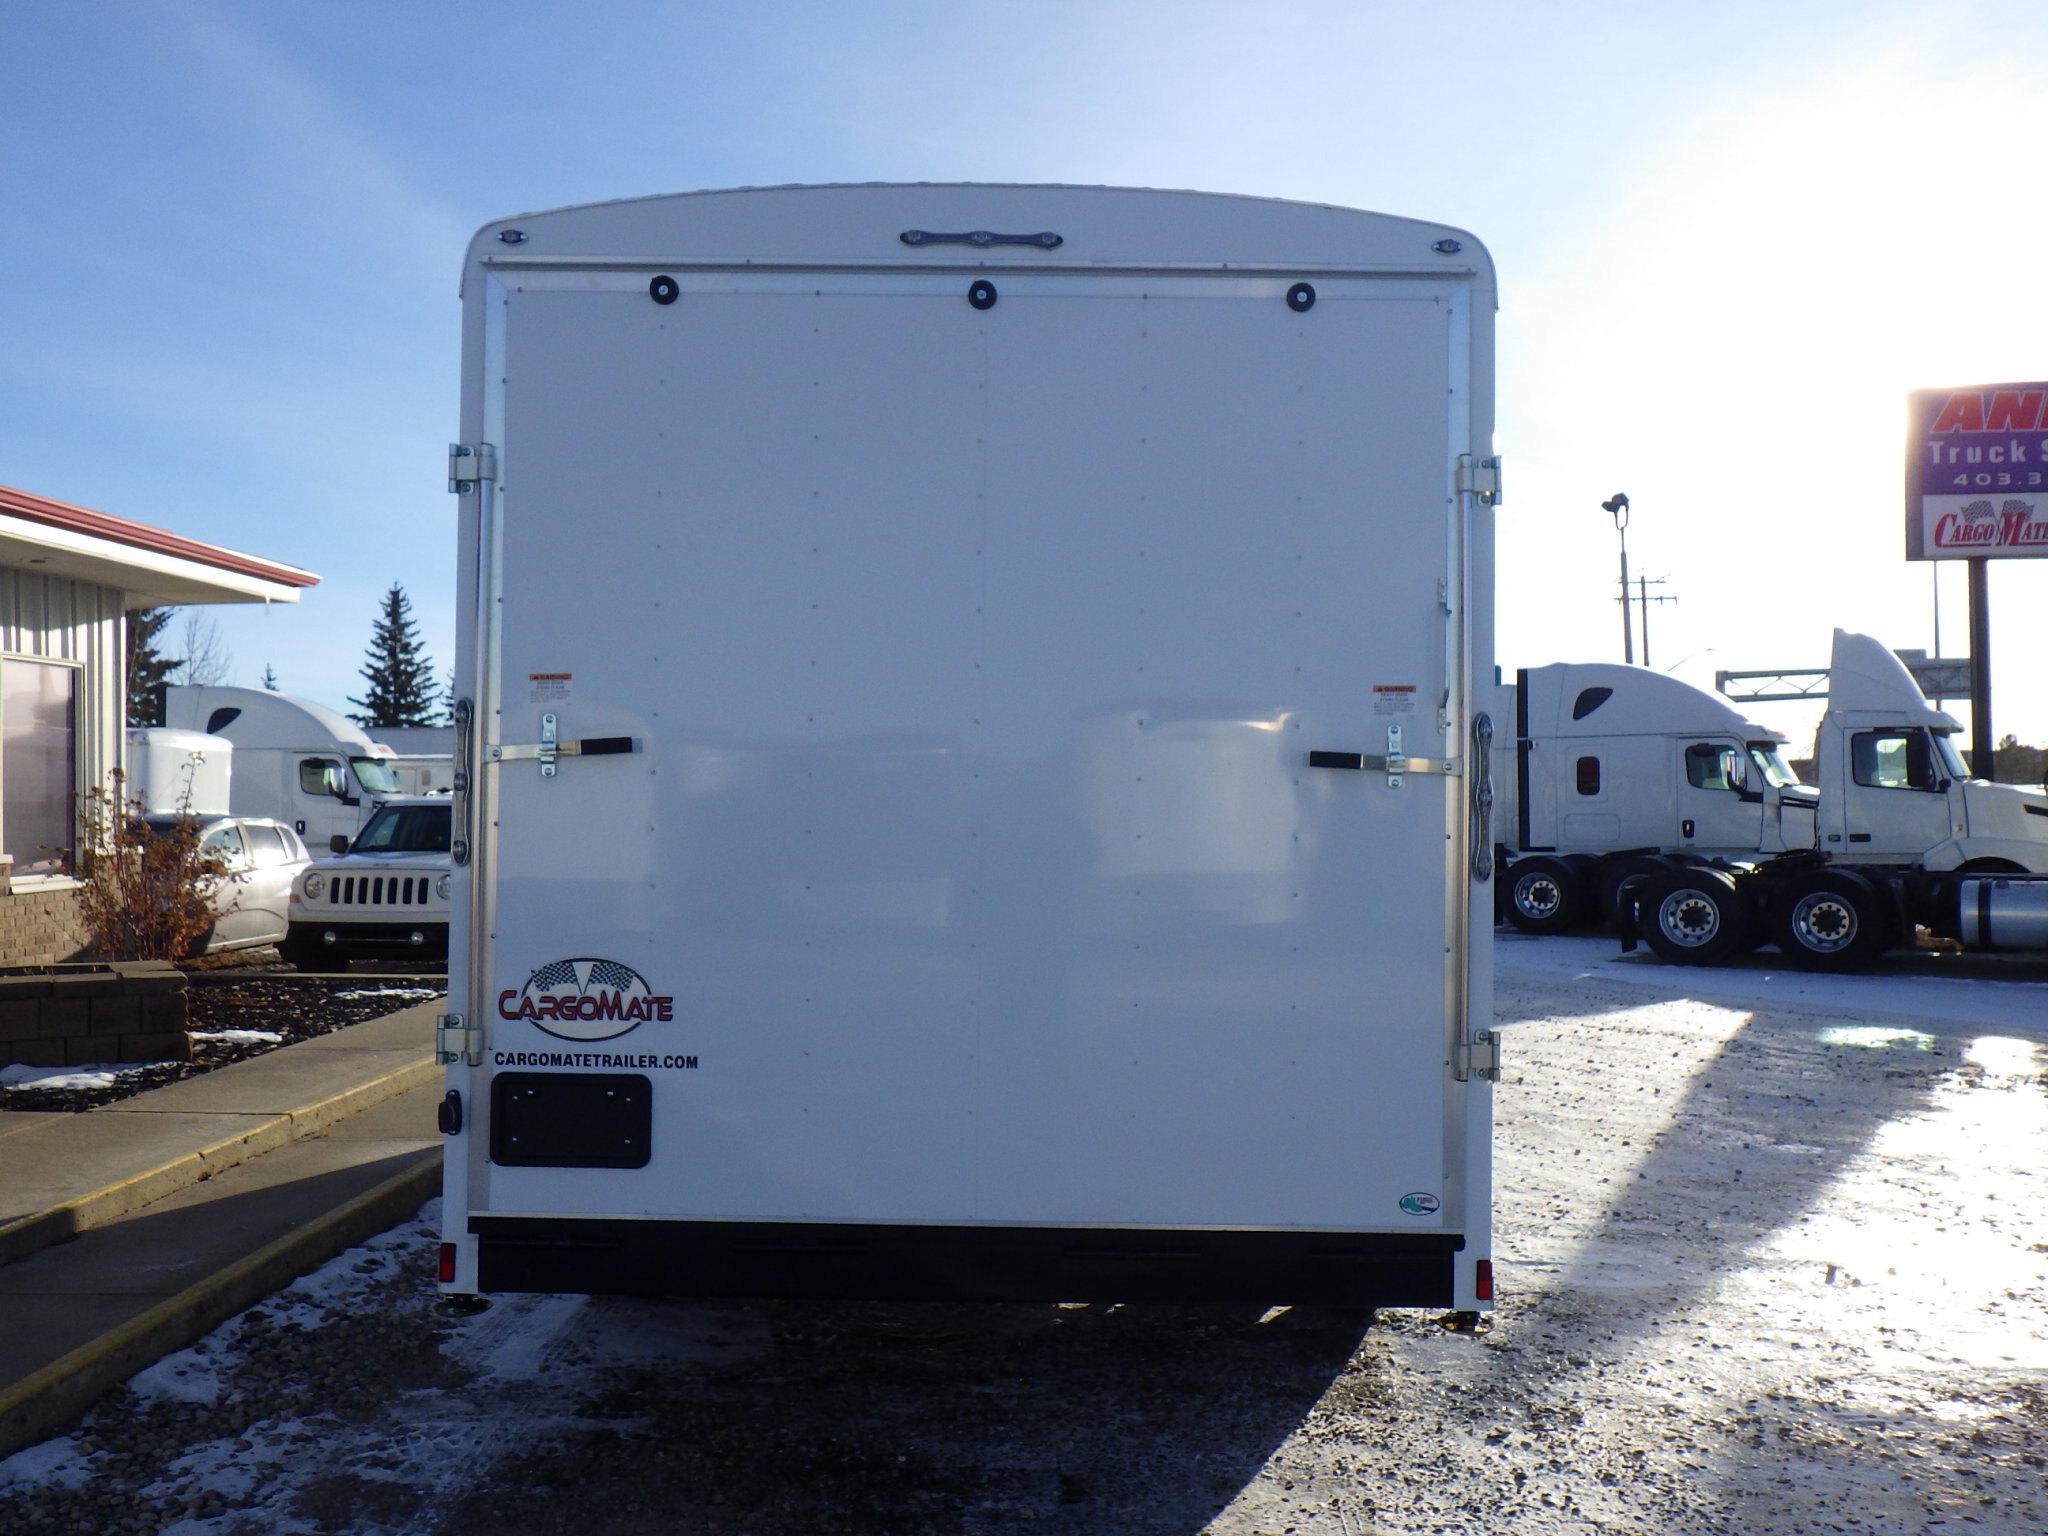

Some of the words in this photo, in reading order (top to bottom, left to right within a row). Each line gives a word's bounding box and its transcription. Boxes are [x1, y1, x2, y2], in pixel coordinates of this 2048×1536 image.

[1929, 389, 2048, 433] AN
[1927, 439, 2027, 464] Truck
[1953, 471, 2042, 486] 403.3
[498, 989, 674, 1022] CARGOMATE
[494, 1052, 699, 1070] CARGOMATETRAILER.COM
